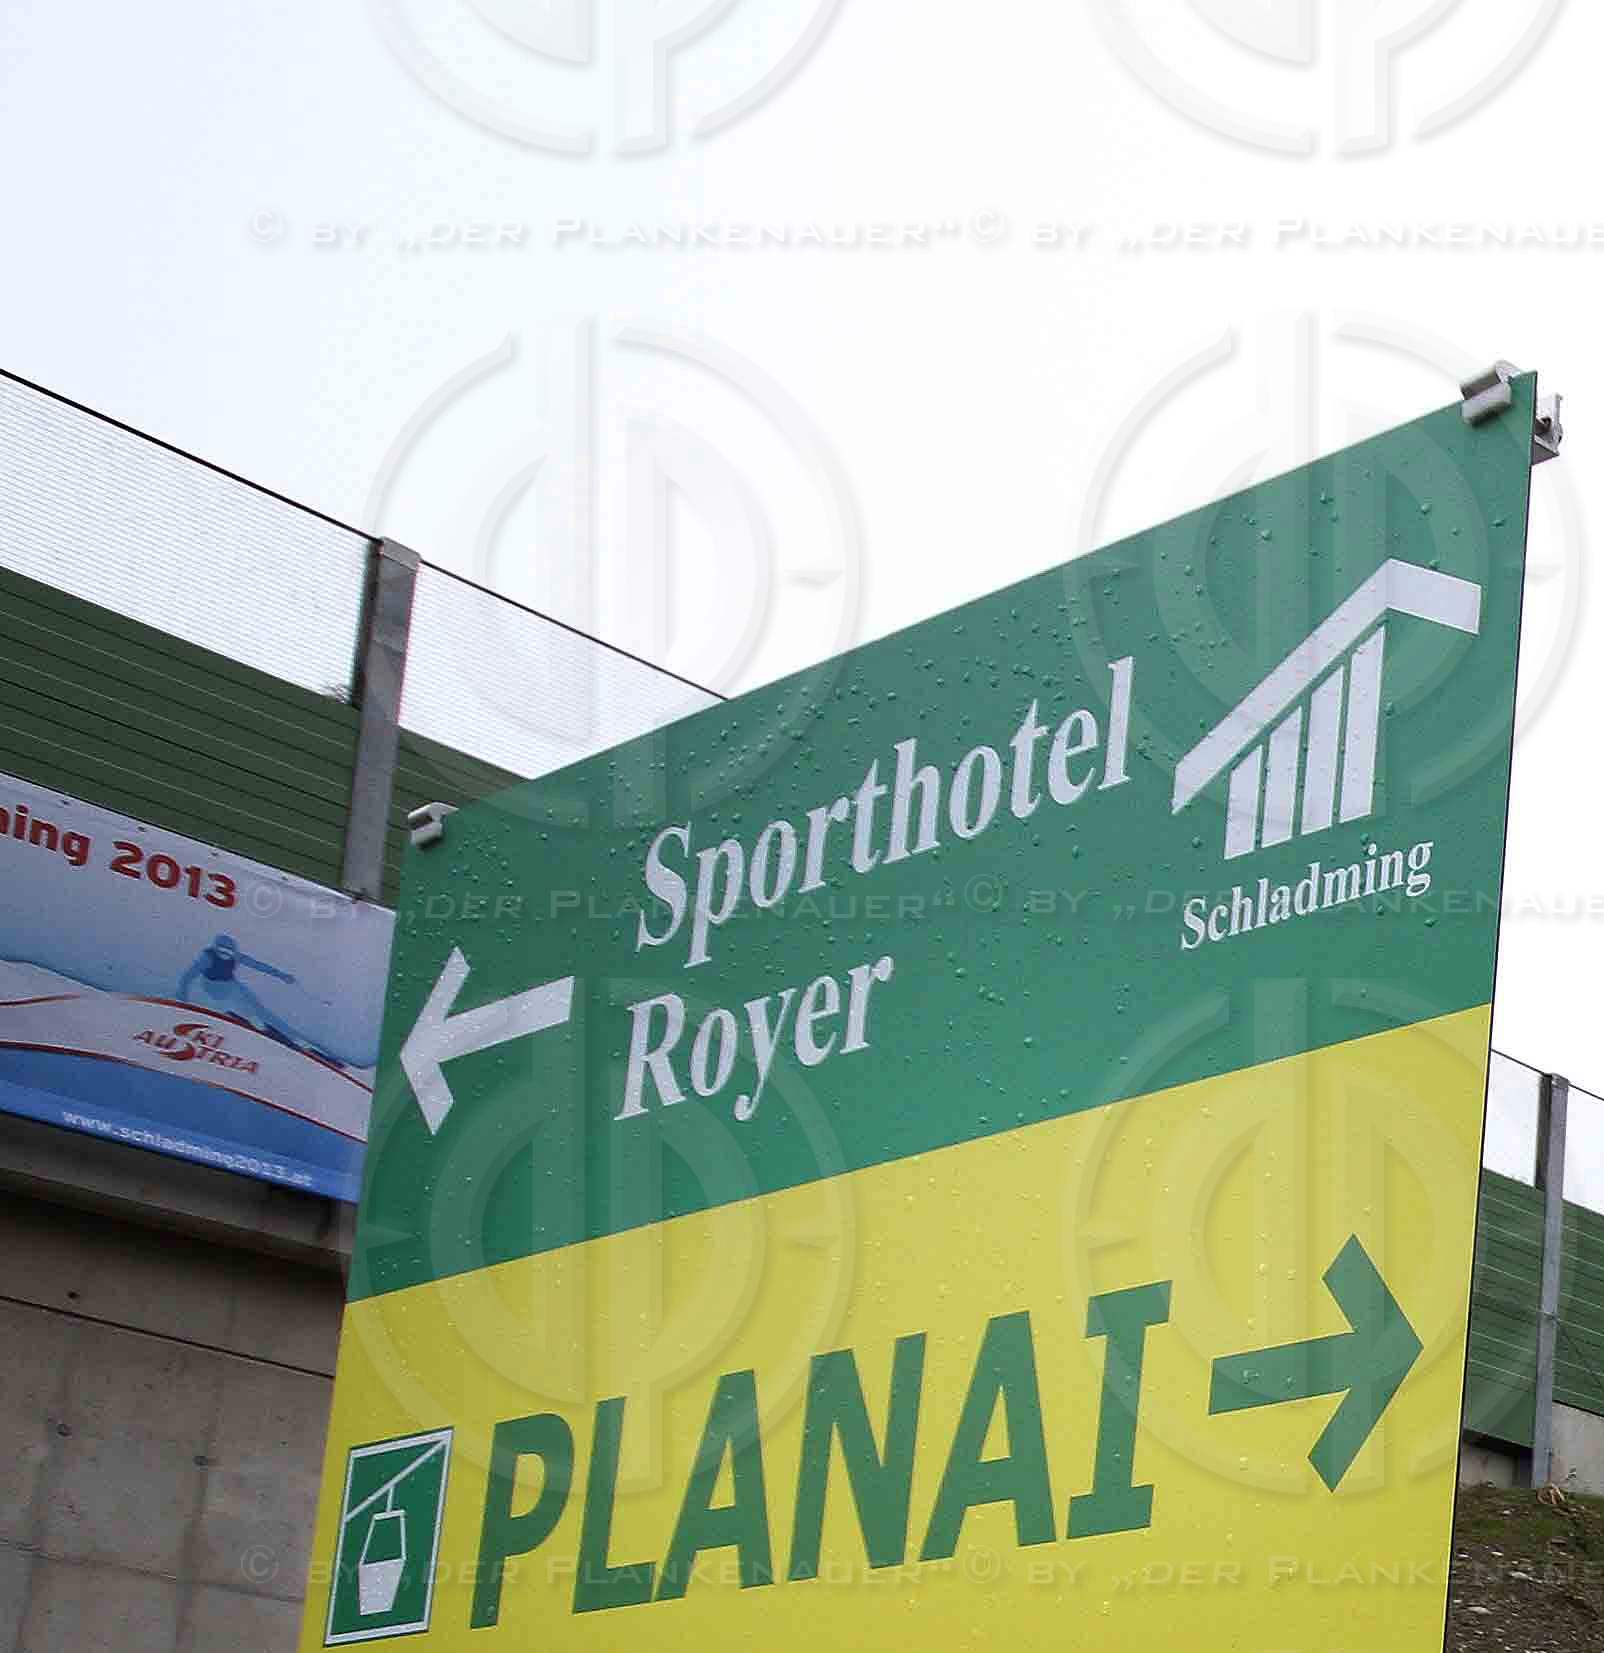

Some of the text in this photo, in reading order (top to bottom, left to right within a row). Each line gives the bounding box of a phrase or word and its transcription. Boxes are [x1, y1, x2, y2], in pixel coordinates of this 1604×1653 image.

[109, 840, 238, 909] 2013
[636, 655, 1136, 965] Sporthotel
[1180, 838, 1435, 952] Schladming
[613, 953, 895, 1122] Royer
[470, 1279, 1173, 1630] PLANAI
